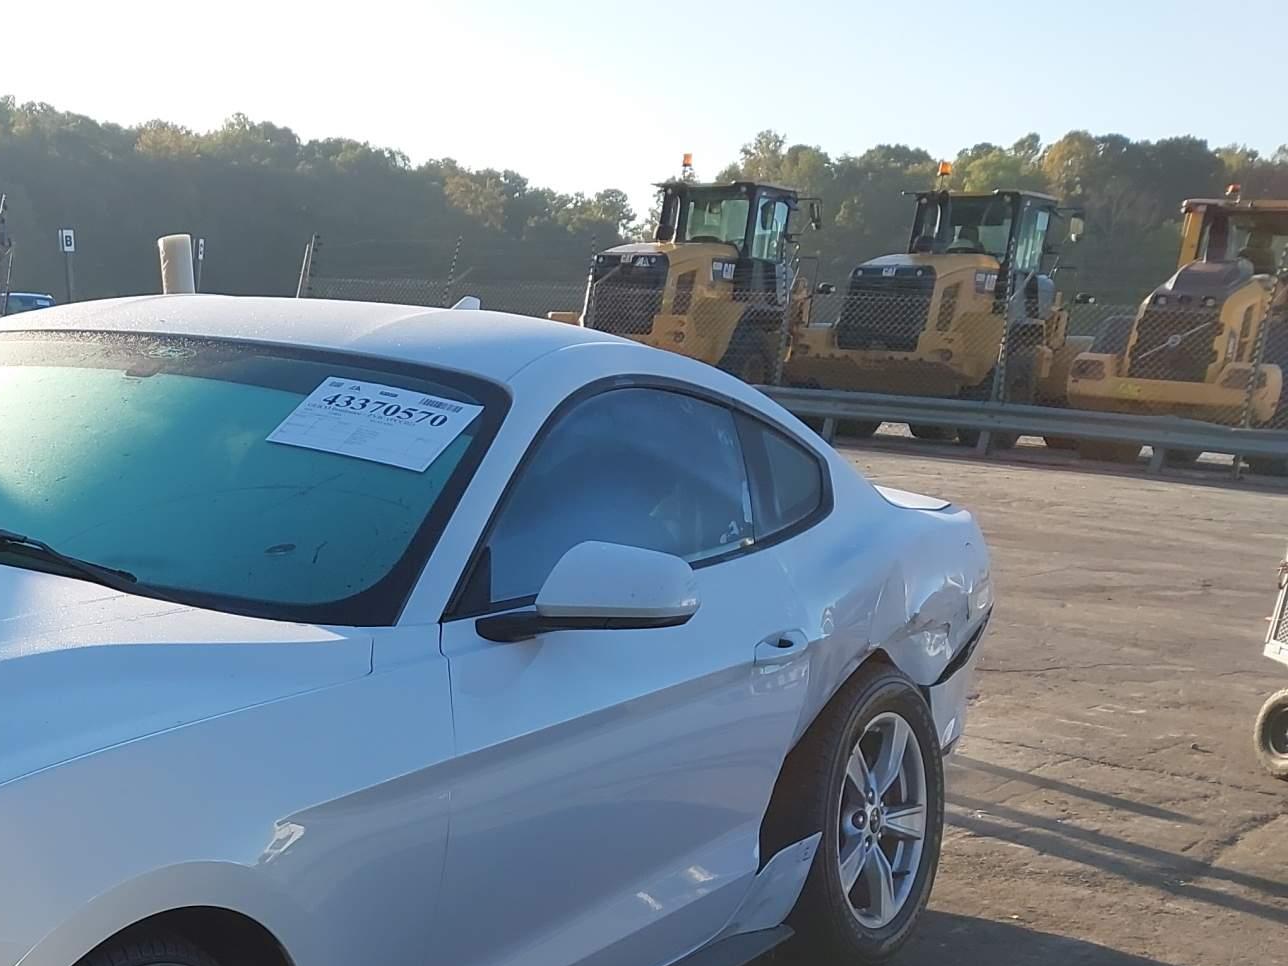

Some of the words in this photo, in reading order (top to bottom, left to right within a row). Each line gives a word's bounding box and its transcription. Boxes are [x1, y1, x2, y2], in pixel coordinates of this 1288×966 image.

[65, 235, 72, 247] B
[882, 267, 896, 277] CAT
[323, 393, 447, 426] 43370570
